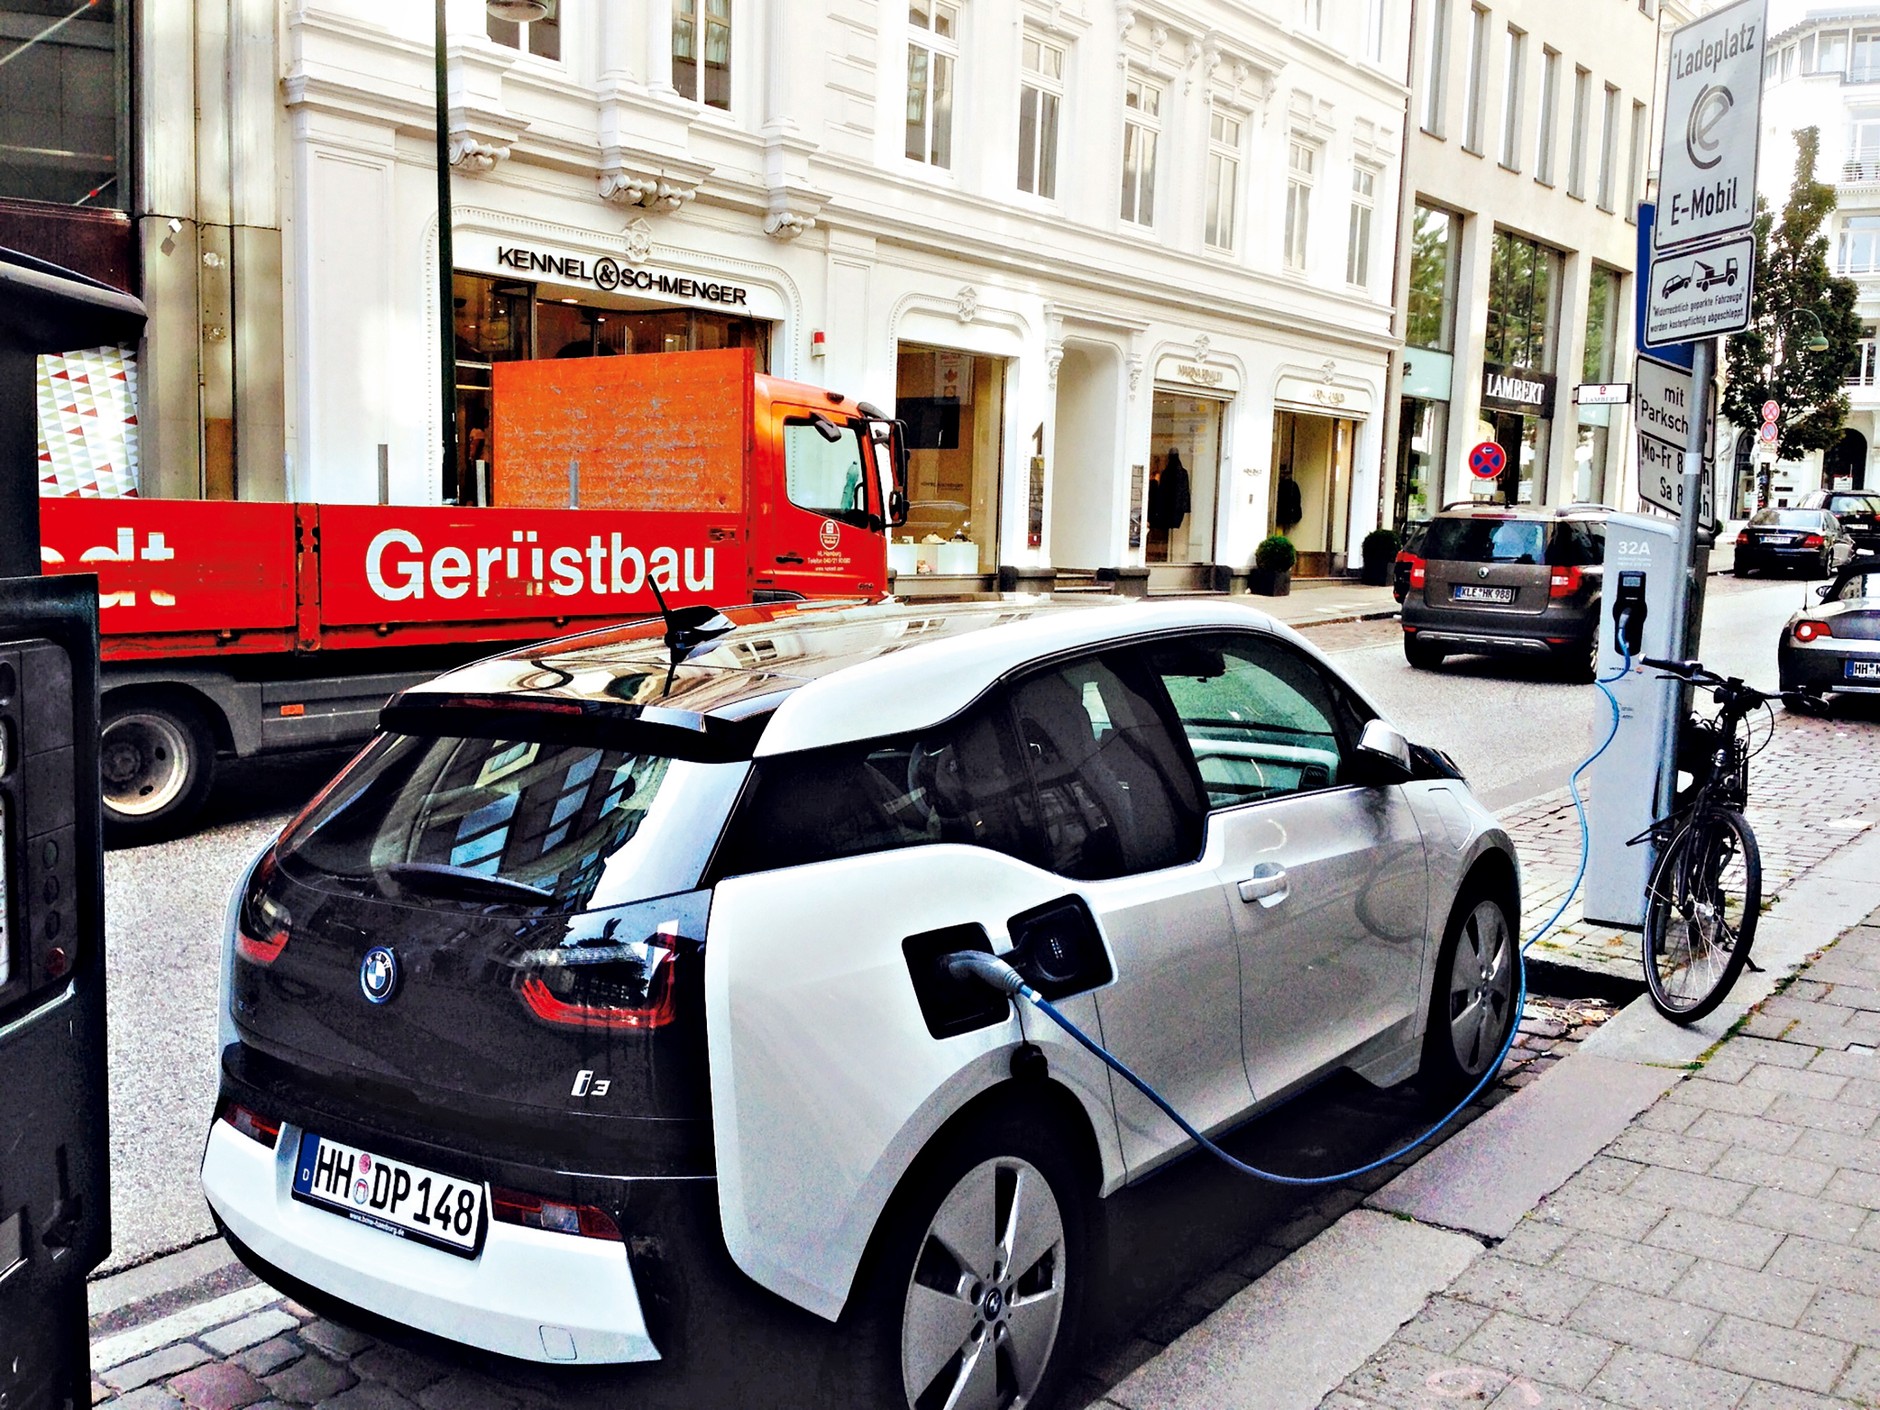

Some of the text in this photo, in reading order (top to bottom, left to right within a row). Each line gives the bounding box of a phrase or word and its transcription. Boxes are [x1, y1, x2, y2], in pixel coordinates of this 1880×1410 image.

[1676, 23, 1755, 80] Ladeplatz
[1671, 177, 1737, 226] E-Mobil
[498, 246, 593, 281] KENNEL
[620, 268, 747, 305] SCHMENGER
[1715, 293, 1743, 306] Fahrzeuge
[1486, 373, 1545, 405] LAMBERT
[1665, 387, 1684, 407] mit
[1641, 399, 1689, 435] Parksch
[1642, 437, 1671, 470] Mo-Fr
[1660, 476, 1672, 501] Sa
[1618, 541, 1651, 555] 32A
[366, 528, 715, 600] Gerüstbau
[1461, 587, 1476, 597] KLE
[1482, 588, 1493, 598] HK
[1854, 663, 1868, 675] HH
[571, 1069, 611, 1097] i3
[302, 1168, 310, 1181] D
[314, 1145, 475, 1236] HH DP 148
